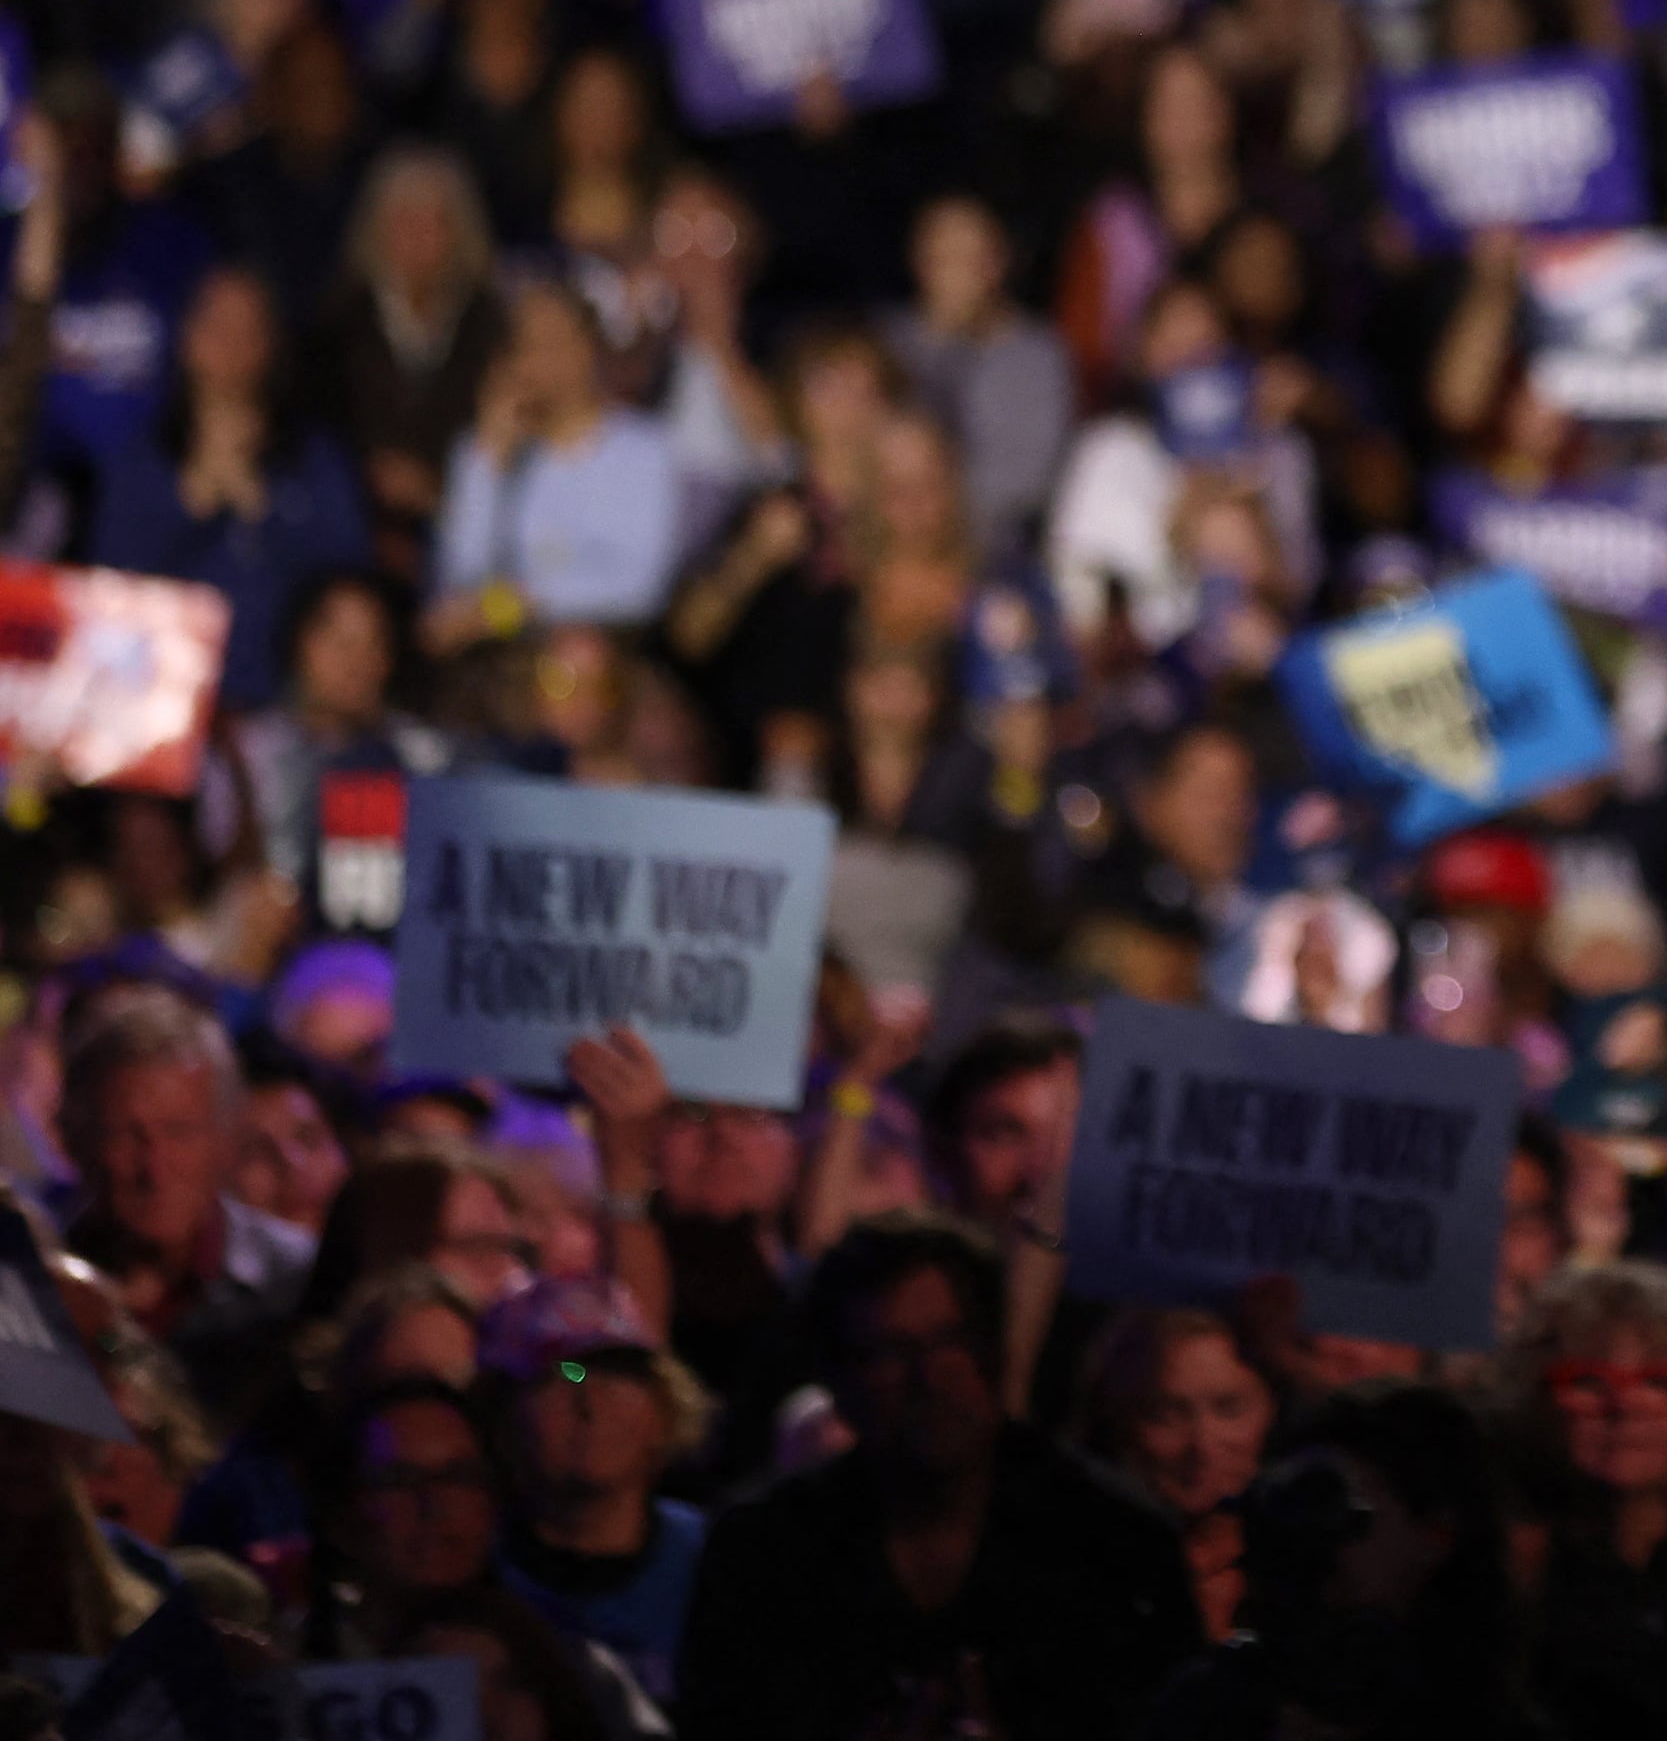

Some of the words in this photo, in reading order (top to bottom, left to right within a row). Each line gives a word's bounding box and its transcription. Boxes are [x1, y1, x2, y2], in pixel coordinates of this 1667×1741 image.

[430, 841, 468, 924] A
[485, 847, 637, 941] NEW
[648, 858, 790, 953] WAY
[447, 936, 752, 1039] FORWARD
[1113, 1063, 1155, 1155] A
[1171, 1069, 1325, 1173] NEW
[1335, 1089, 1480, 1193] WAY
[1121, 1167, 1437, 1287] FORWARD
